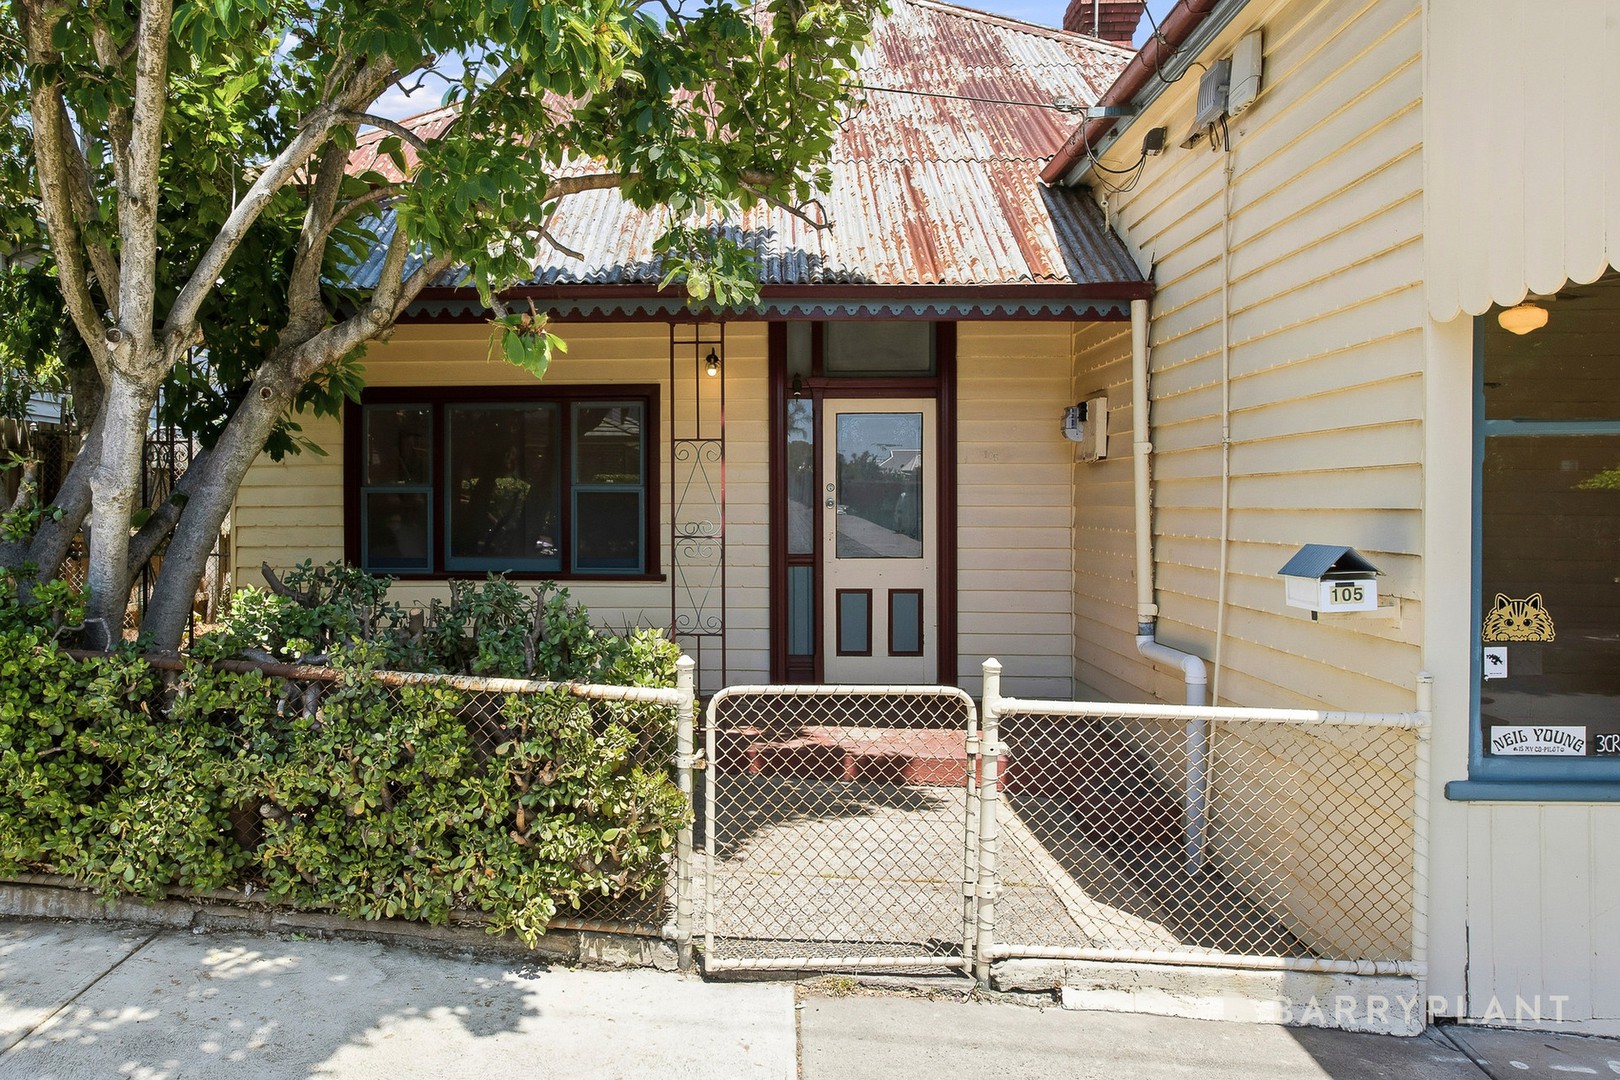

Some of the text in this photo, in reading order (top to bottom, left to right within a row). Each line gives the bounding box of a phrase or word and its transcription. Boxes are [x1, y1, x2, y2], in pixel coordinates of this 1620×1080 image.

[1332, 587, 1363, 602] 105
[1493, 728, 1585, 753] NEIL YOUNG
